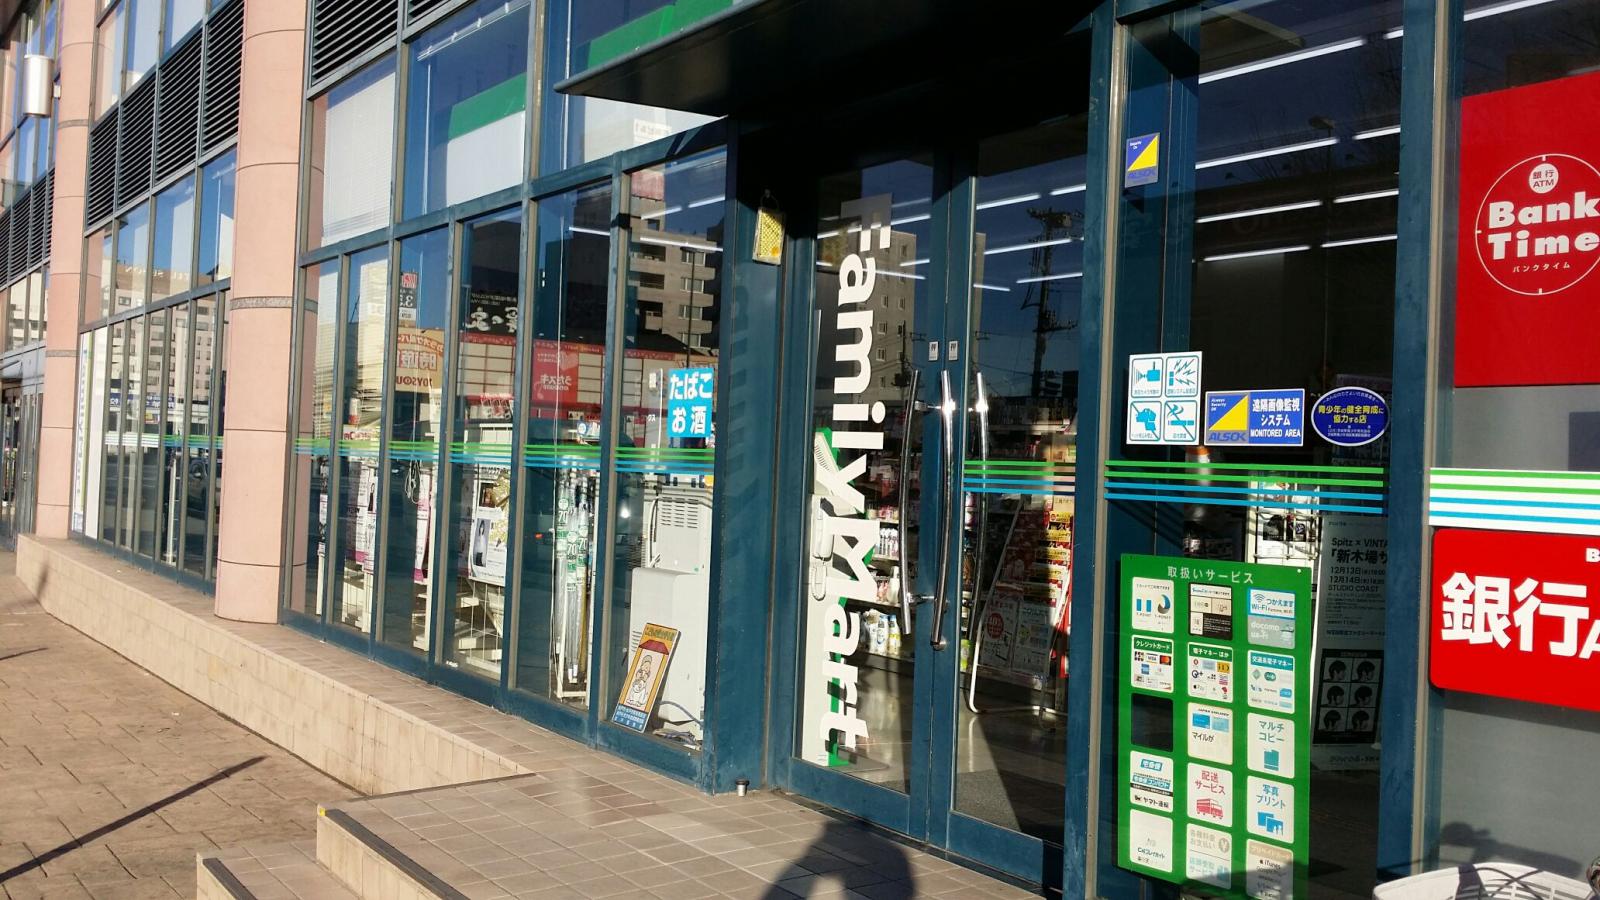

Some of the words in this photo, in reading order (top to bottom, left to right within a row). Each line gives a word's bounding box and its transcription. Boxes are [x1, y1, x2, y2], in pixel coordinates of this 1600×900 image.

[1533, 169, 1555, 180] 銀行
[1533, 178, 1554, 188] ATM
[1488, 191, 1600, 229] Bank
[1488, 230, 1600, 260] Time
[1512, 262, 1571, 273] バンクタイム
[670, 371, 712, 400] たばこ
[1252, 398, 1300, 412] 遠隔画像監視
[1318, 406, 1384, 414] 青少年の健全育成に
[672, 406, 707, 434] お酒
[1261, 414, 1291, 426] システム
[1334, 414, 1366, 424] 協力する店
[1209, 432, 1246, 442] ALSOK
[1250, 429, 1282, 438] MONITORED
[1285, 429, 1301, 438] AREA
[1332, 538, 1352, 547] Spitz
[1167, 566, 1254, 584] 取扱いサービス
[1266, 598, 1293, 607] つかえます
[1250, 621, 1280, 631] docomo
[1136, 640, 1170, 650] クレジットカード
[1192, 648, 1217, 656] 電子マネー
[1259, 720, 1284, 733] マルチ
[1192, 732, 1214, 742] マイルが
[1259, 733, 1284, 743] コピー
[1202, 770, 1218, 783] 配送
[1195, 780, 1226, 795] サービス
[1262, 784, 1278, 796] 写真
[1144, 796, 1168, 808] ヤマト運輸
[1256, 794, 1286, 809] プリント
[1264, 860, 1281, 869] iTunes
